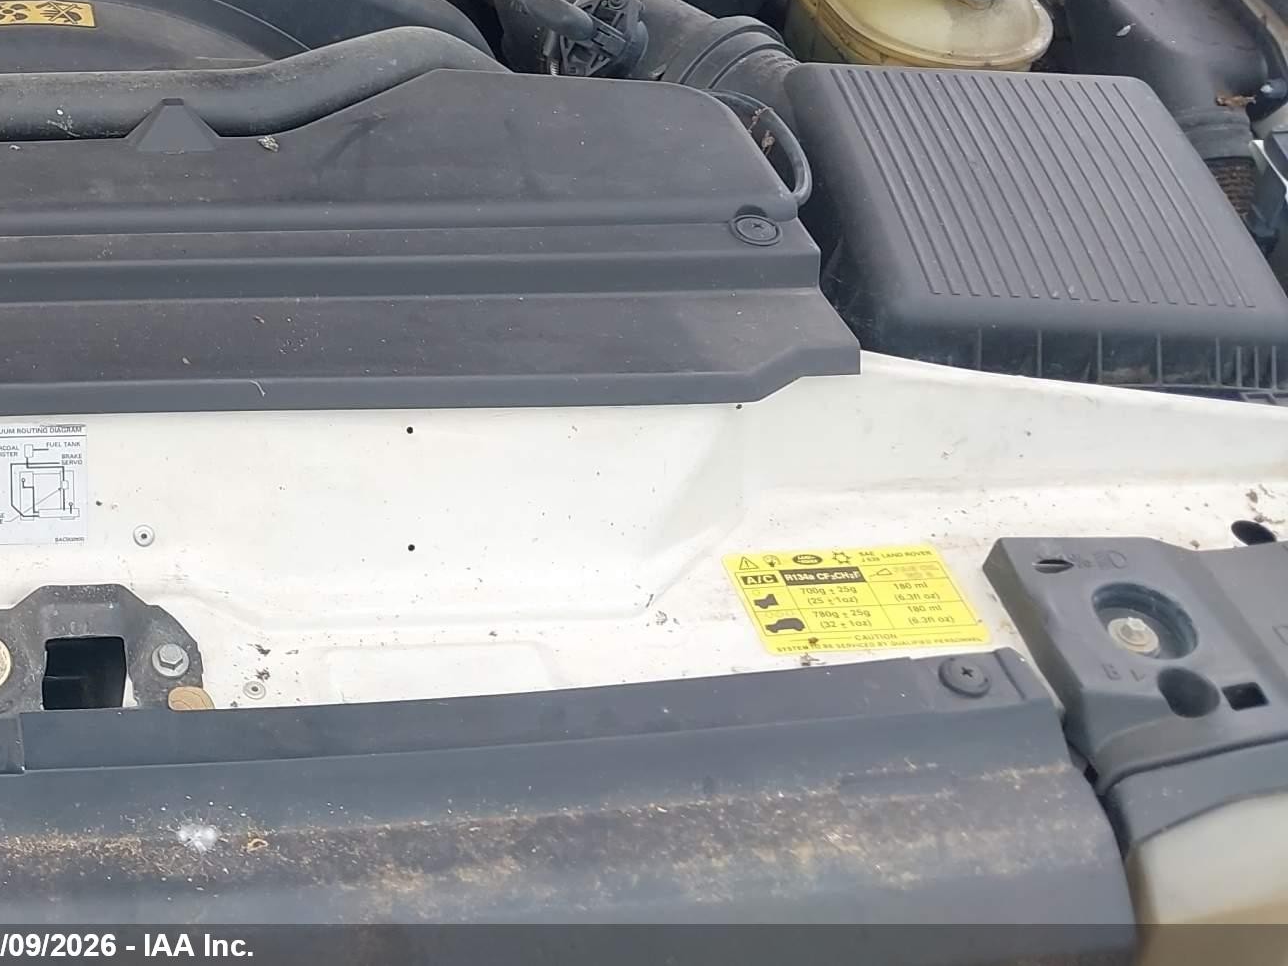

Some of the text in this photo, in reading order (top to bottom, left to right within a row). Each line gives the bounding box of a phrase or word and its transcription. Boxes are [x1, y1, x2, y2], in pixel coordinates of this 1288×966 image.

[745, 575, 776, 585] A/C
[784, 573, 815, 582] R134a
[800, 586, 826, 595] 700g
[837, 585, 857, 594] 25g
[922, 591, 941, 600] oz)
[807, 597, 824, 605] (25
[907, 605, 924, 613] 180
[812, 610, 839, 619] 780g
[850, 609, 871, 618] 25g
[937, 614, 955, 623] oz)
[819, 620, 836, 628] (32
[854, 633, 898, 641] CAUTION
[776, 645, 809, 653] SYSTEM
